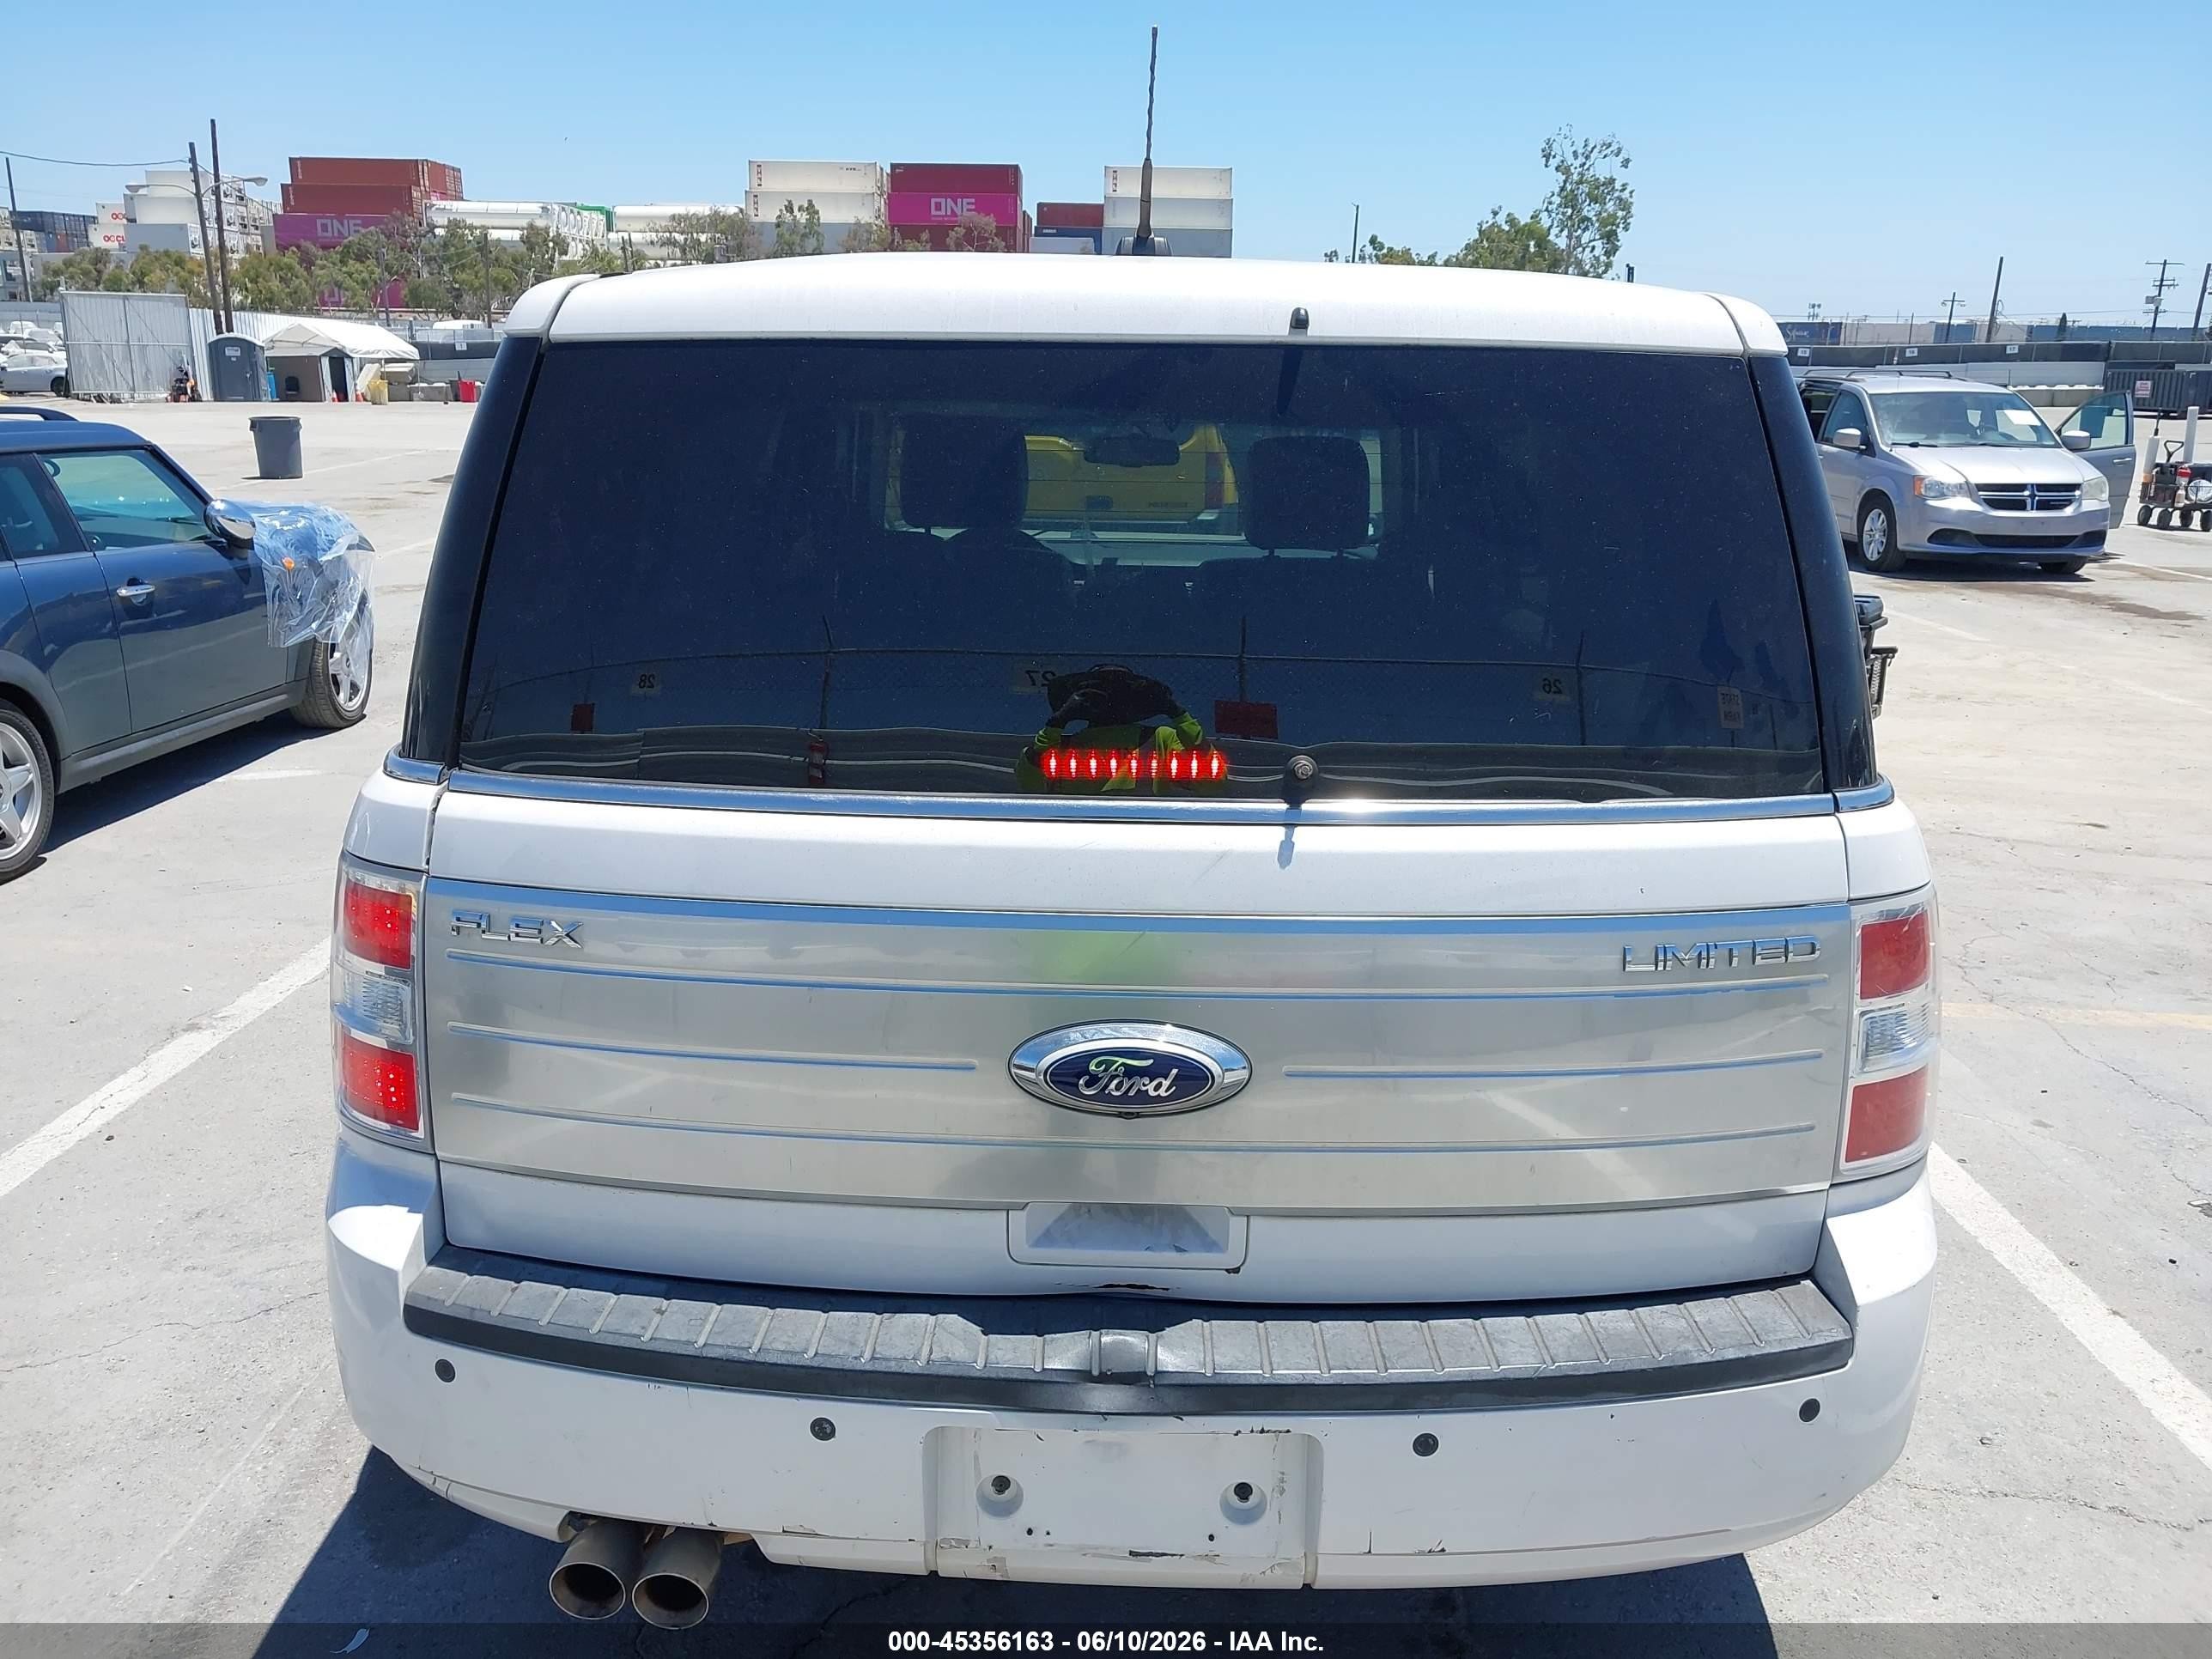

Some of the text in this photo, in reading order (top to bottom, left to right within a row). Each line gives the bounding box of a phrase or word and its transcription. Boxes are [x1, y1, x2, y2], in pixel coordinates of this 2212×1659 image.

[931, 198, 975, 216] ONE
[316, 218, 362, 238] ONE
[451, 909, 584, 949] FLEX
[1623, 934, 1821, 972] LIMITED
[1078, 1055, 1178, 1097] Ford
